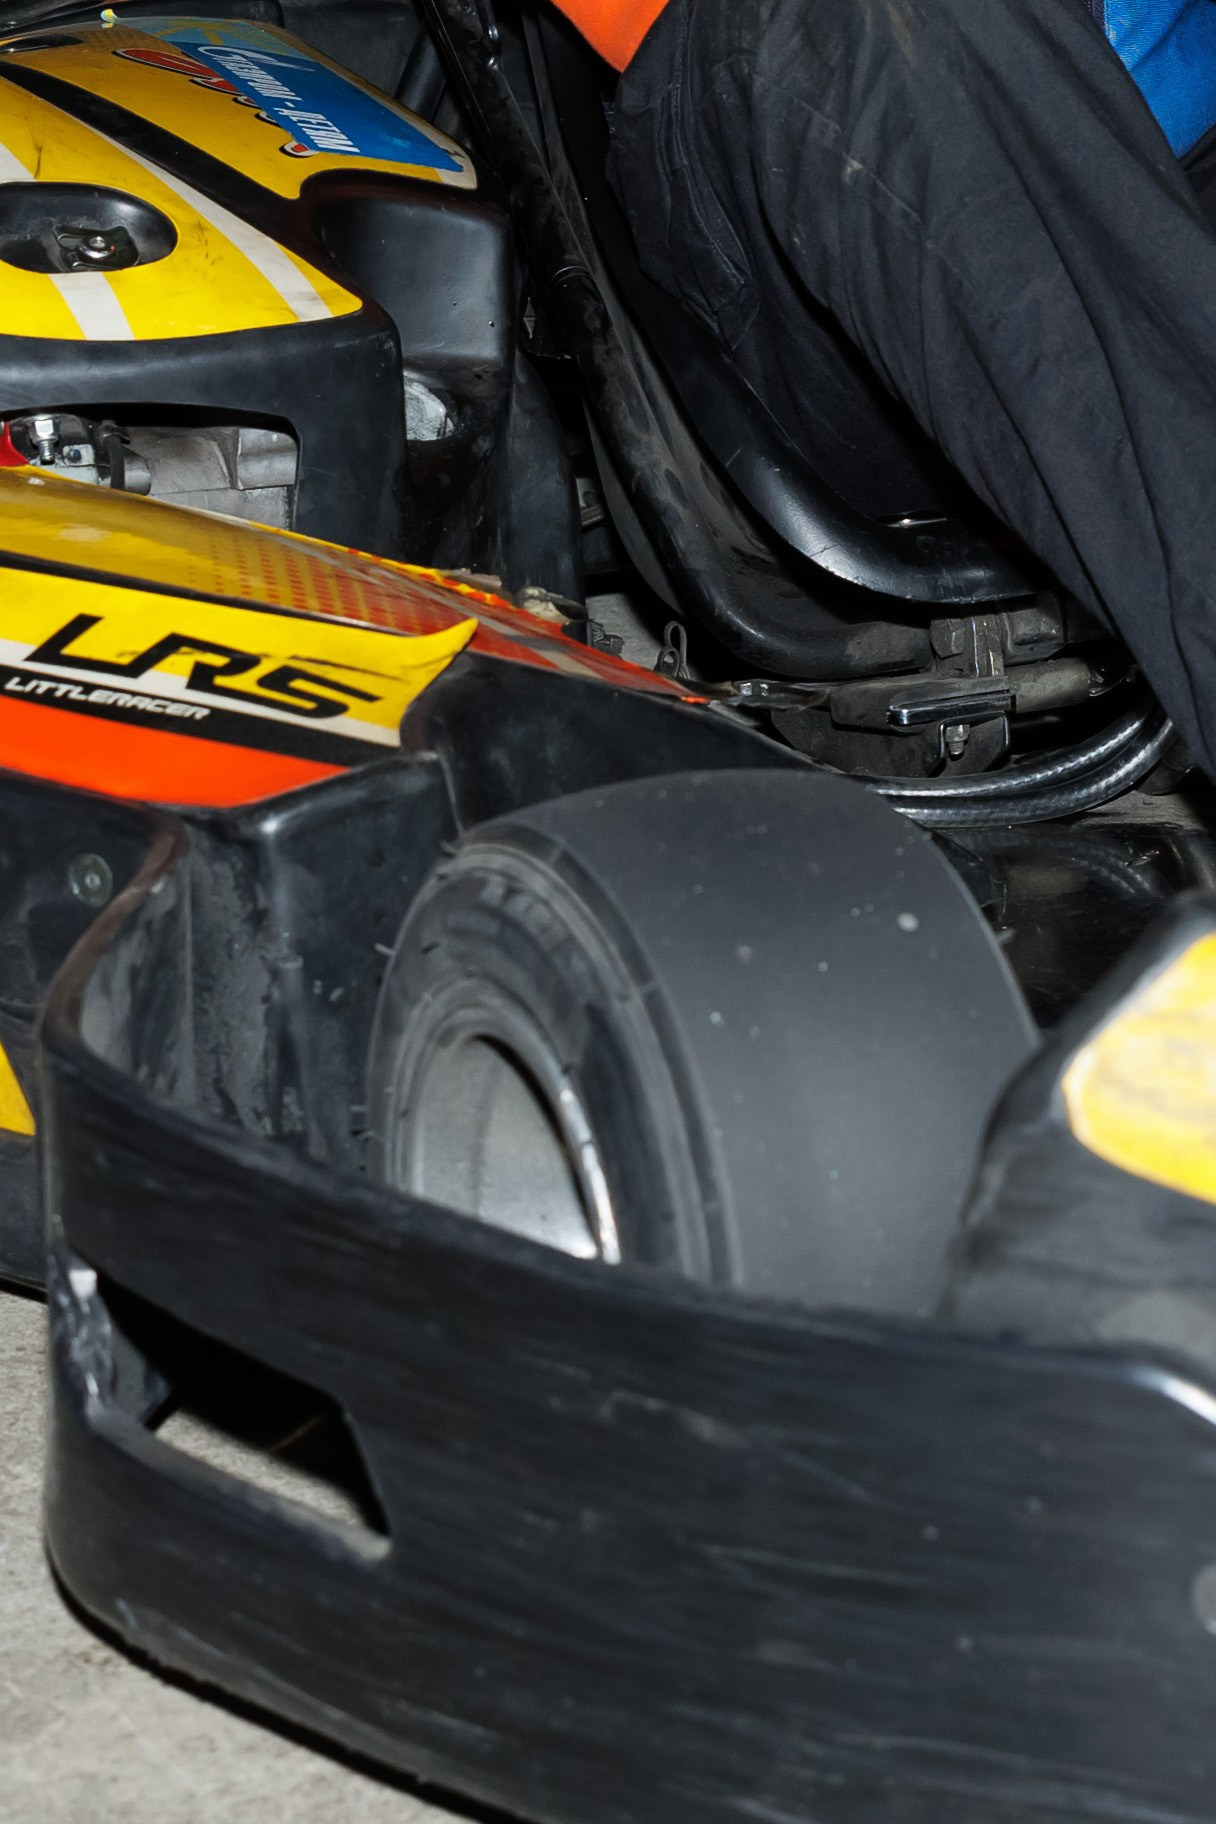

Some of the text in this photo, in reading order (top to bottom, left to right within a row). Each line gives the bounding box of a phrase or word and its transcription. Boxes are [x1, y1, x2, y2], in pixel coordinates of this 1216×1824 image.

[273, 107, 361, 154] ДЕТЯМ
[24, 613, 384, 719] LRS
[4, 676, 211, 721] LITTLERACER
